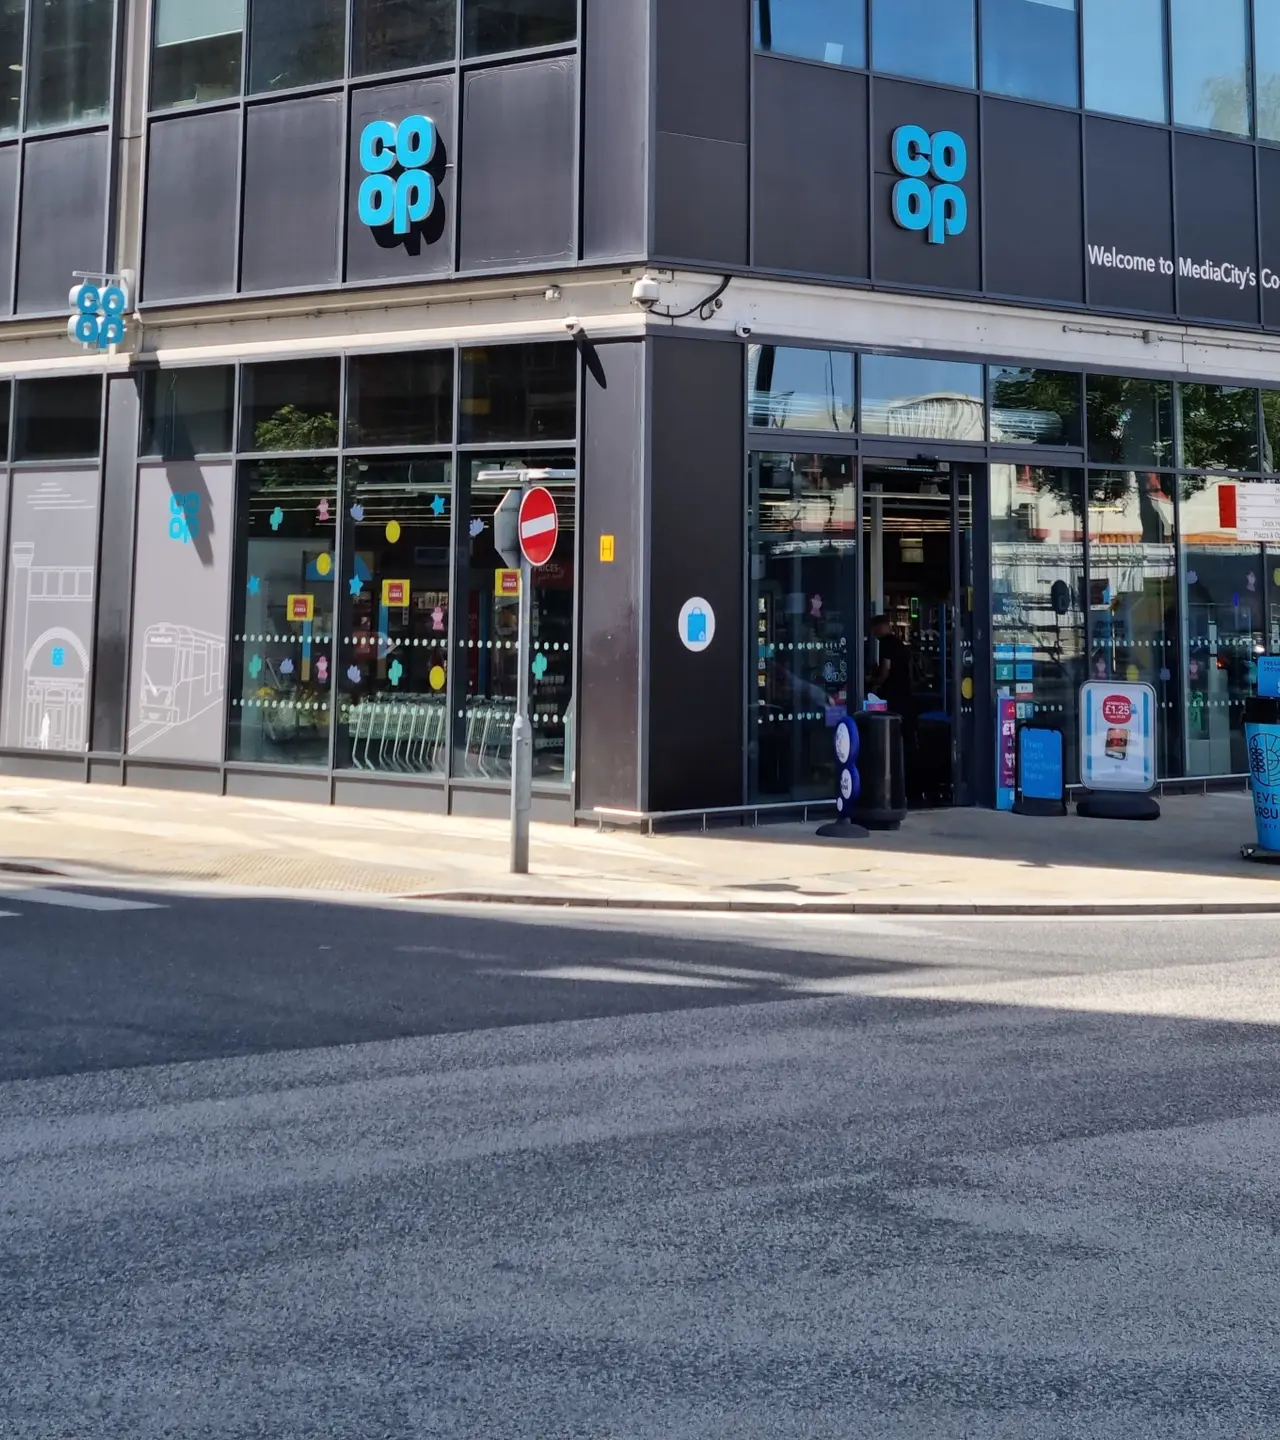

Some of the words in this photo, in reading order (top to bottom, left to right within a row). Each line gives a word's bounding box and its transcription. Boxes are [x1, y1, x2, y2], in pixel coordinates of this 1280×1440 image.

[1087, 244, 1156, 273] Welcome
[1158, 256, 1174, 275] to
[1178, 256, 1257, 290] MediaCity's
[1262, 519, 1275, 527] Dock
[1105, 705, 1130, 715] £1.25
